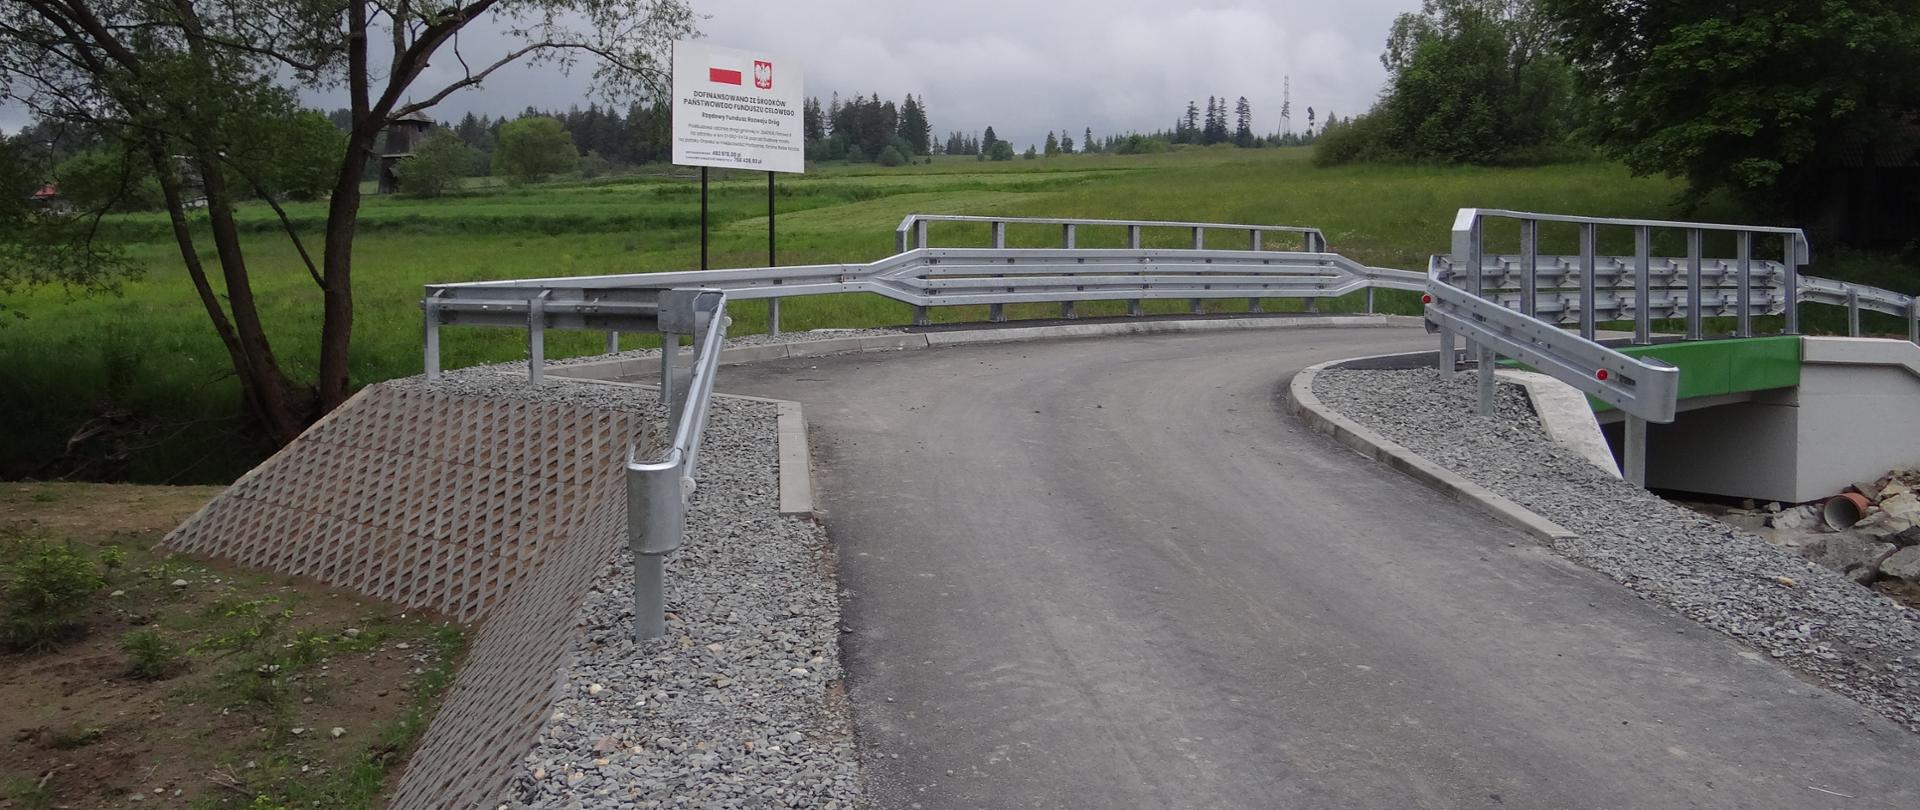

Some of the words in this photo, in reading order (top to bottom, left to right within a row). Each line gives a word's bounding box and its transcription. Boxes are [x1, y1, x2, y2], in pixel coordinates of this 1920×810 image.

[683, 98, 733, 110] PAŃSTWOWEGO
[733, 104, 764, 113] FUNDUSZU
[764, 107, 795, 116] CELOWEGO
[693, 90, 749, 103] DOFINANSOWANO
[757, 96, 786, 107] ŚRODKÓW
[747, 117, 768, 125] Rozwoju
